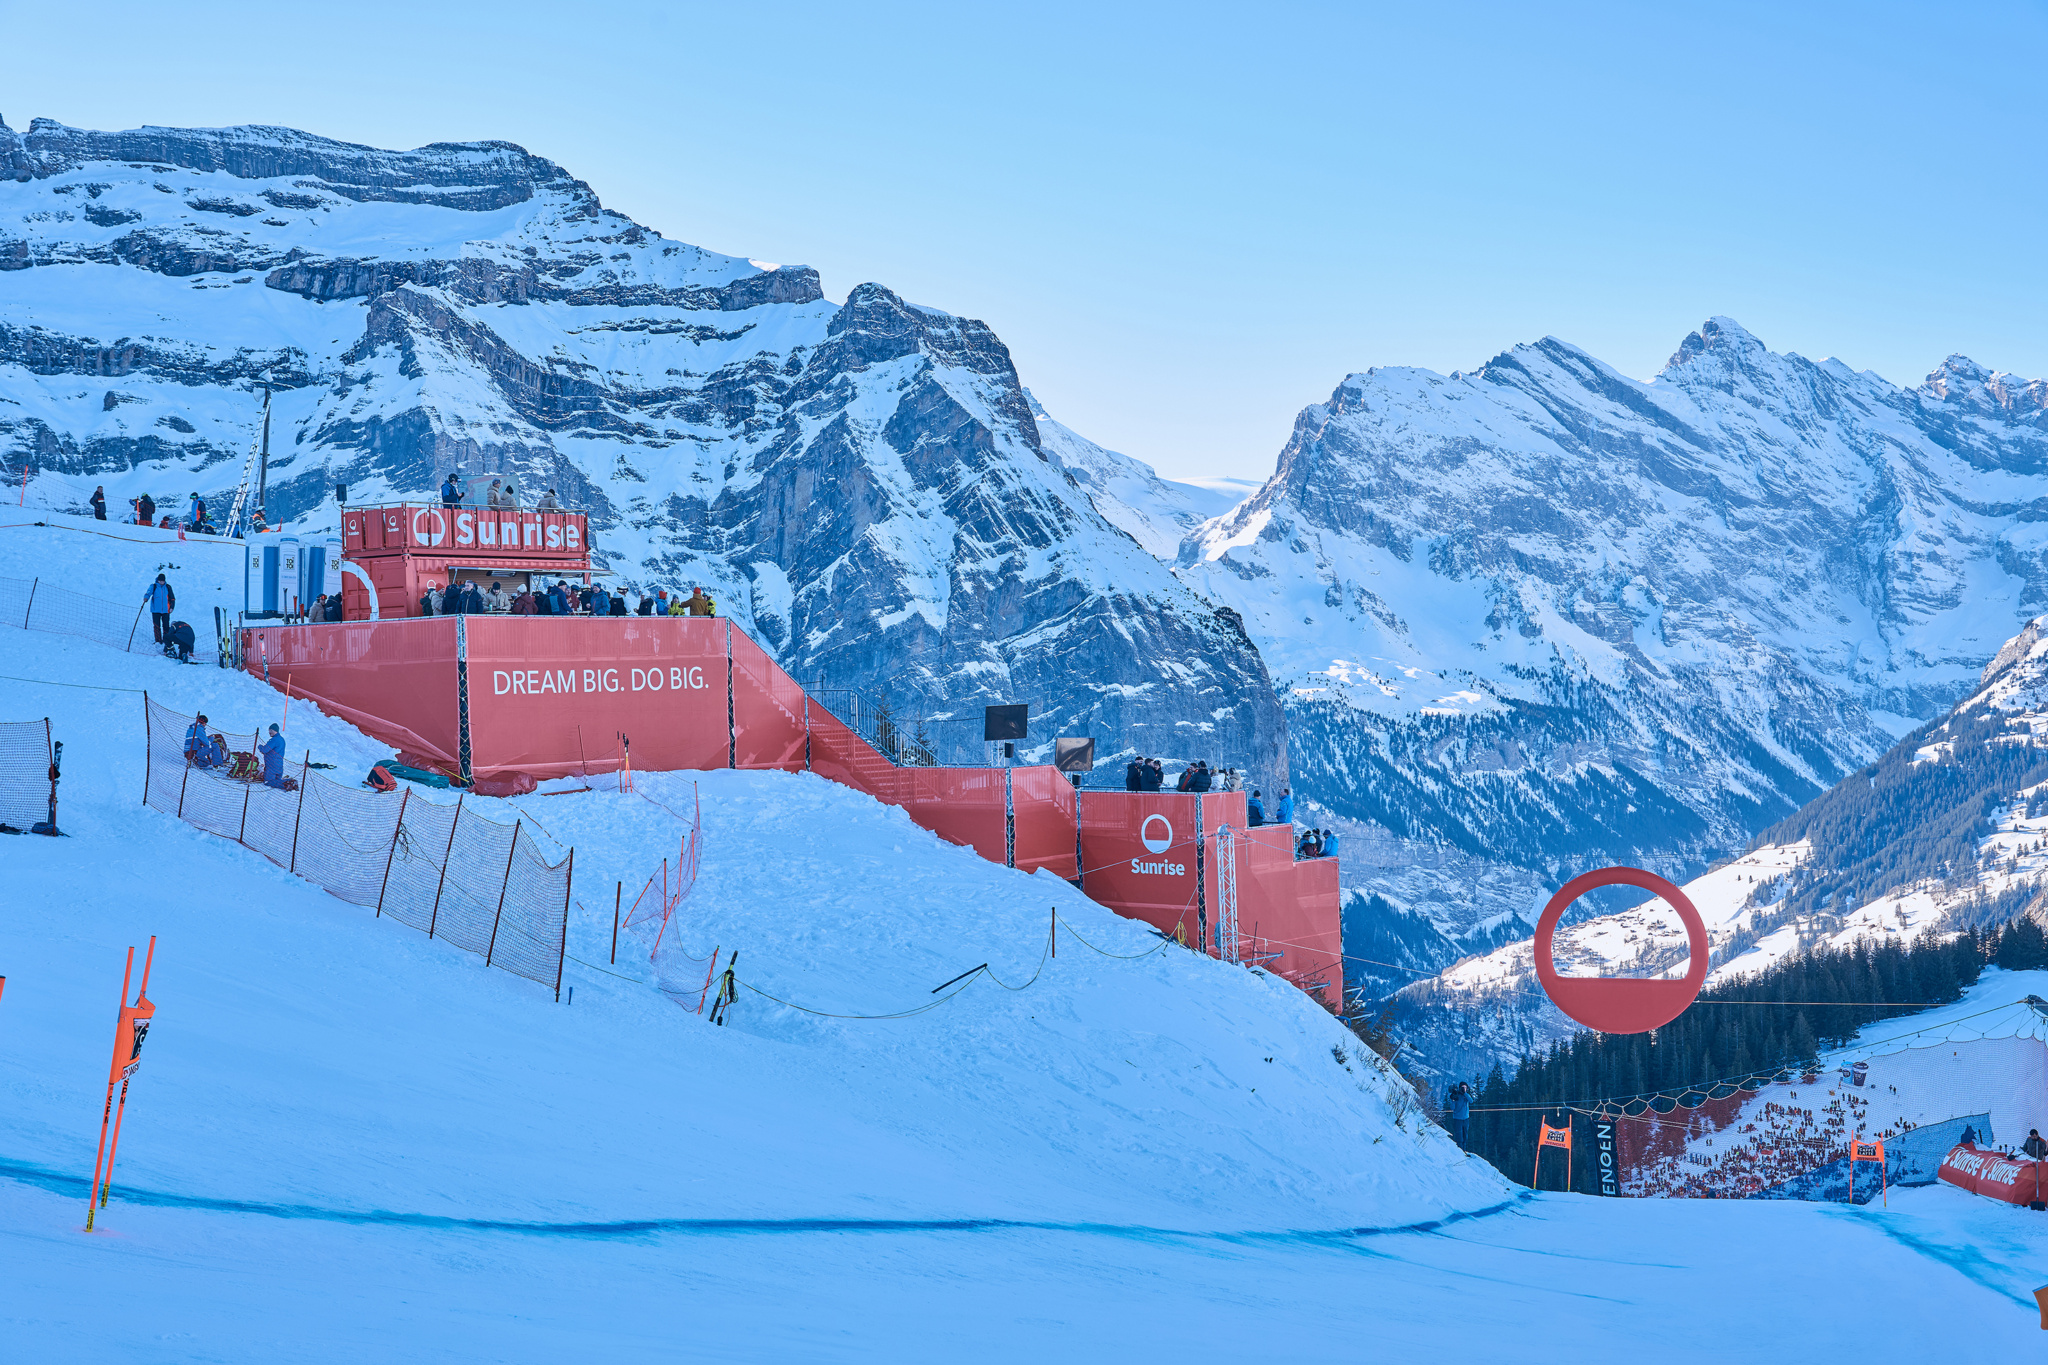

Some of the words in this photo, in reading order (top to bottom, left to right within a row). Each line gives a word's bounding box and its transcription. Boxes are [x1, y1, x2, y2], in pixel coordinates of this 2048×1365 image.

[456, 513, 580, 548] Sunrise
[493, 670, 576, 695] DREAM
[583, 668, 625, 693] BIG.
[631, 667, 664, 691] DO
[670, 666, 709, 690] BIG.
[1131, 858, 1185, 876] Sunrise
